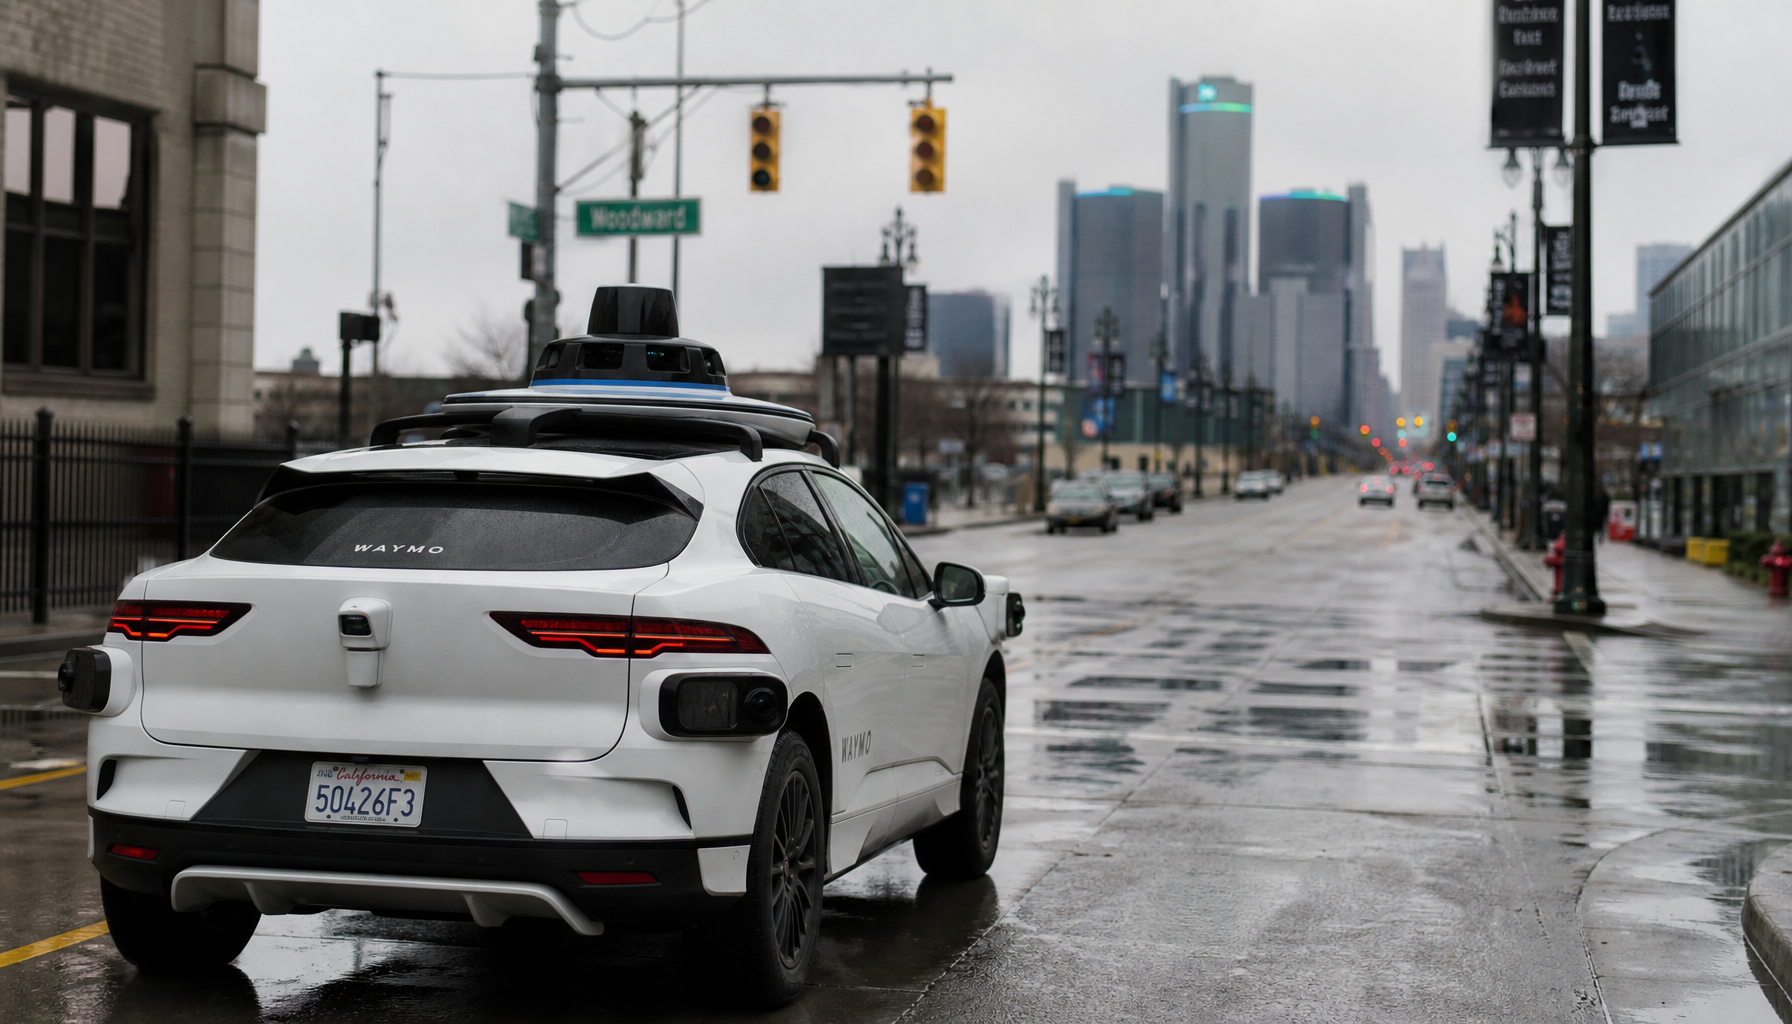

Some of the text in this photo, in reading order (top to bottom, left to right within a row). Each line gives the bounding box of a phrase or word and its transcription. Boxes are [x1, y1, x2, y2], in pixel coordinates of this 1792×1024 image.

[589, 205, 687, 231] Woodward
[354, 544, 444, 554] WAYMO
[841, 730, 872, 763] WAYMO
[336, 767, 401, 786] California
[315, 784, 415, 817] 50426F3
